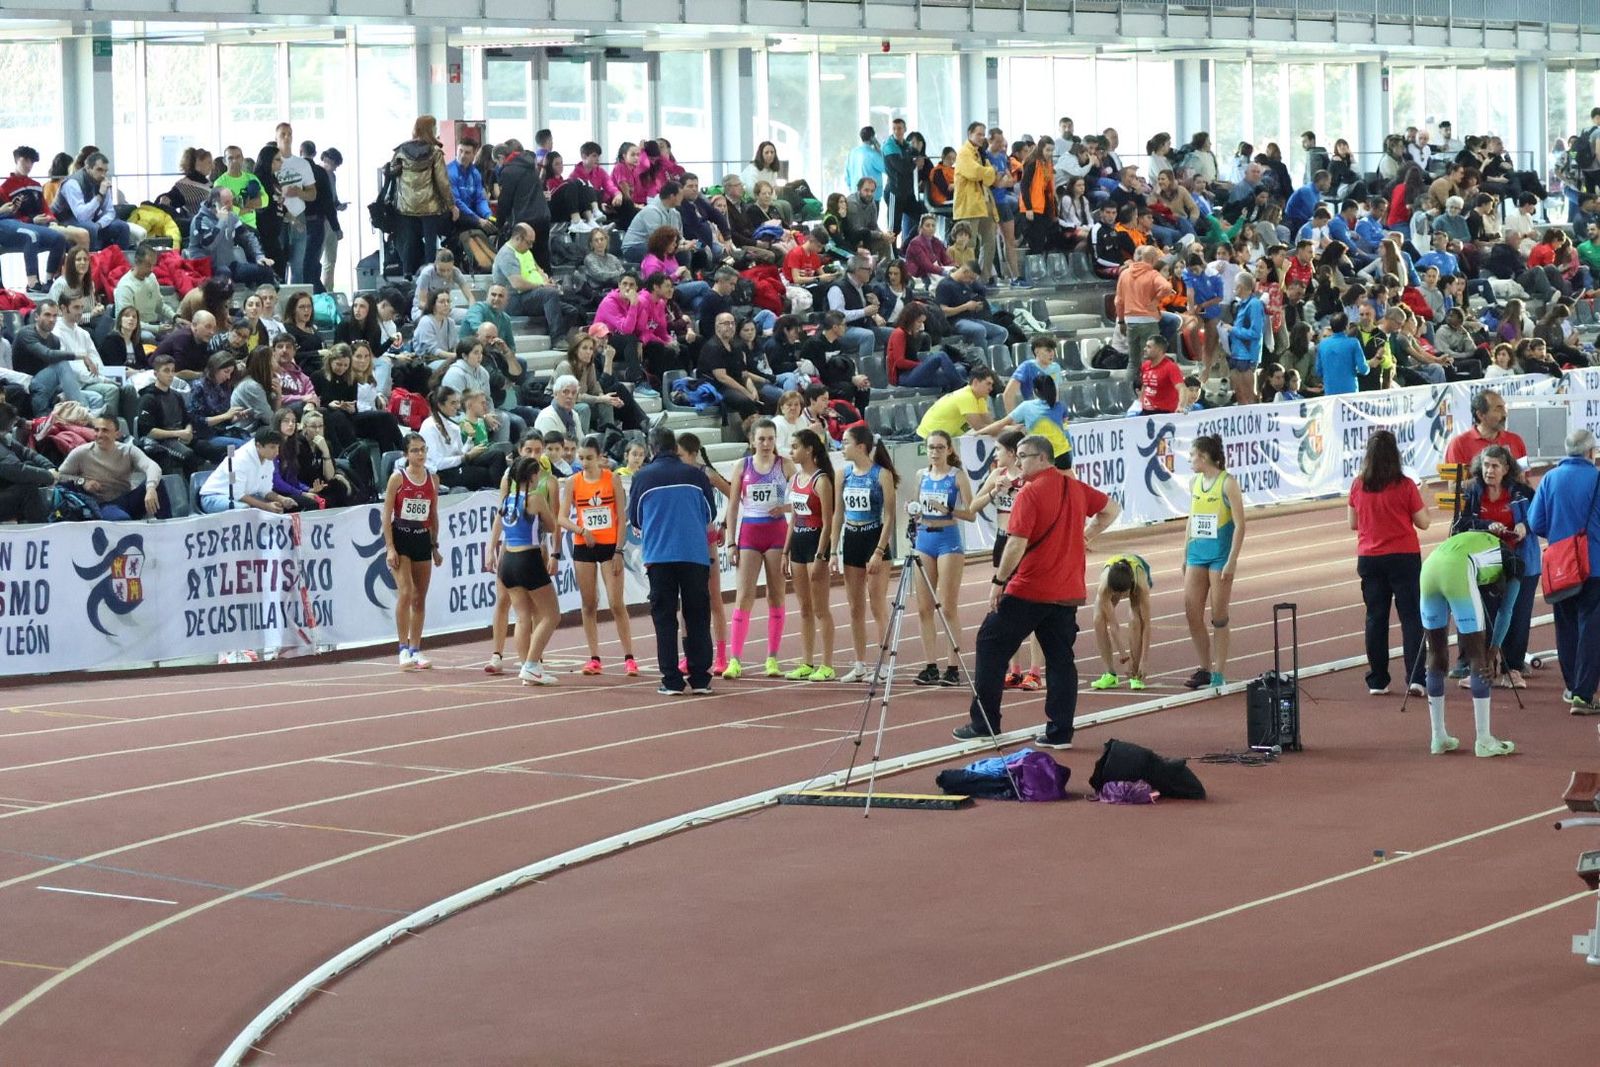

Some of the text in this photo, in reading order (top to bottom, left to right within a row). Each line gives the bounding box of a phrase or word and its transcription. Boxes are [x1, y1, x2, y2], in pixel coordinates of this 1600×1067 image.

[1110, 429, 1124, 452] DE
[406, 503, 427, 514] 5868
[752, 491, 771, 501] 507
[587, 514, 608, 526] 3793
[311, 524, 335, 550] DE
[25, 540, 50, 570] DE
[186, 558, 333, 600] ATLETISMO
[450, 584, 469, 613] DE
[184, 608, 206, 637] DE
[207, 601, 277, 635] CASTILLA
[280, 602, 292, 628] Y
[6, 619, 50, 655] LEÓN
